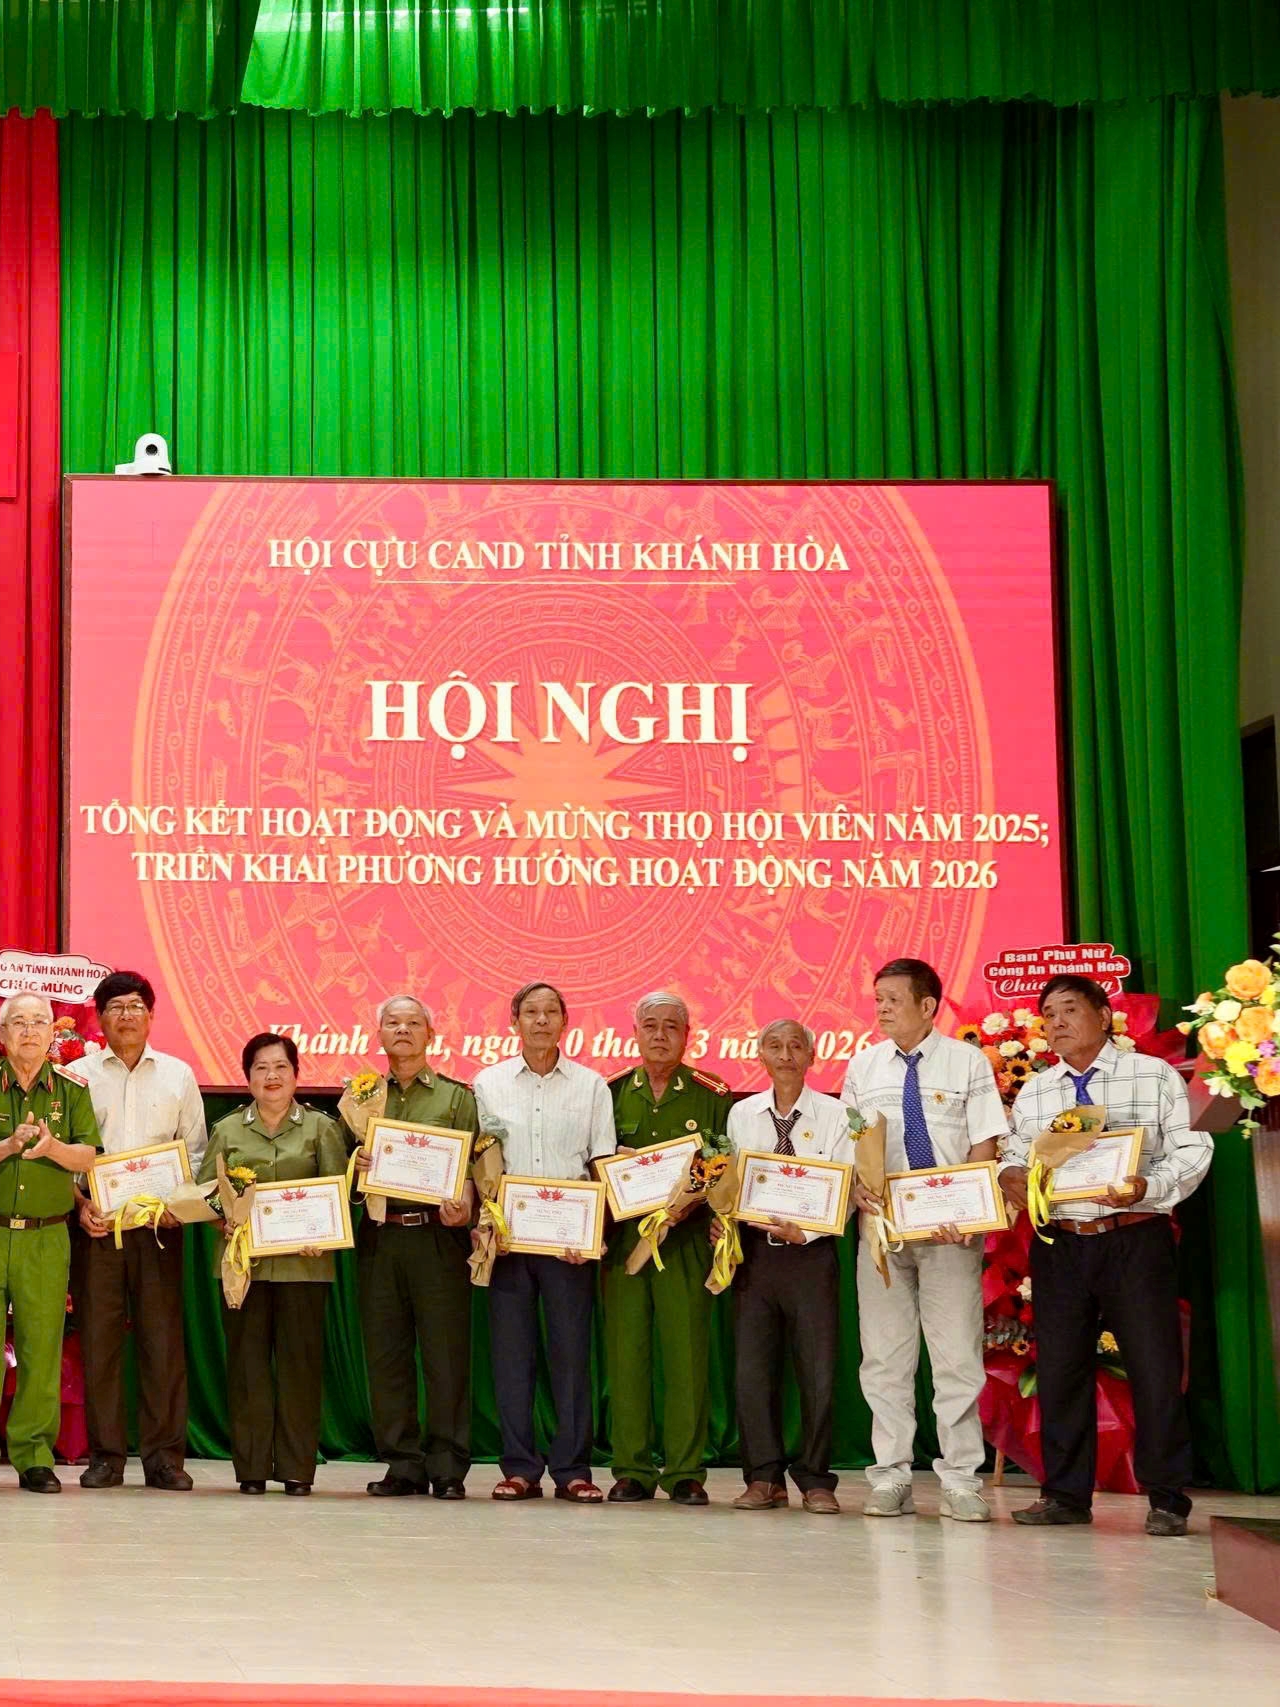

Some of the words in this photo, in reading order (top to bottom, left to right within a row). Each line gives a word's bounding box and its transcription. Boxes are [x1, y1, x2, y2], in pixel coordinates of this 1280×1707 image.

[268, 536, 334, 575] HỘI
[343, 536, 419, 576] CỰU
[428, 541, 525, 570] CAND
[535, 533, 623, 570] TỈNH
[632, 535, 761, 571] KHÁNH
[772, 535, 851, 571] HÒA
[364, 670, 520, 760] HỘI
[540, 680, 754, 762] NGHỊ
[80, 799, 177, 836] TỔNG
[184, 800, 253, 836] KẾT
[261, 807, 355, 844] HOẠT
[365, 805, 462, 846] ĐỘNG
[470, 802, 519, 840] VÀ
[524, 802, 632, 841] MỪNG
[639, 811, 713, 849] THỌ
[722, 808, 785, 849] HỘI
[793, 804, 877, 842] VIÊN
[884, 806, 963, 842] NĂM
[972, 813, 1050, 848] 2025;
[131, 845, 234, 882] TRIỂN
[243, 853, 329, 883] KHAI
[338, 850, 483, 886] PHƯƠNG
[494, 849, 619, 886] HƯỚNG
[628, 857, 724, 895] HOẠT
[734, 855, 833, 896] ĐỘNG
[842, 852, 923, 889] NĂM
[930, 860, 998, 890] 2026
[10, 962, 24, 974] AN
[989, 965, 1024, 977] Công
[1028, 965, 1046, 975] An
[1049, 962, 1094, 975] Khánh
[1004, 952, 1038, 963] Ban
[1043, 950, 1076, 962] Phụ
[1082, 948, 1107, 960] Nữ
[461, 1026, 521, 1065] ngà
[719, 1030, 759, 1059] nă
[812, 1030, 874, 1061] 026
